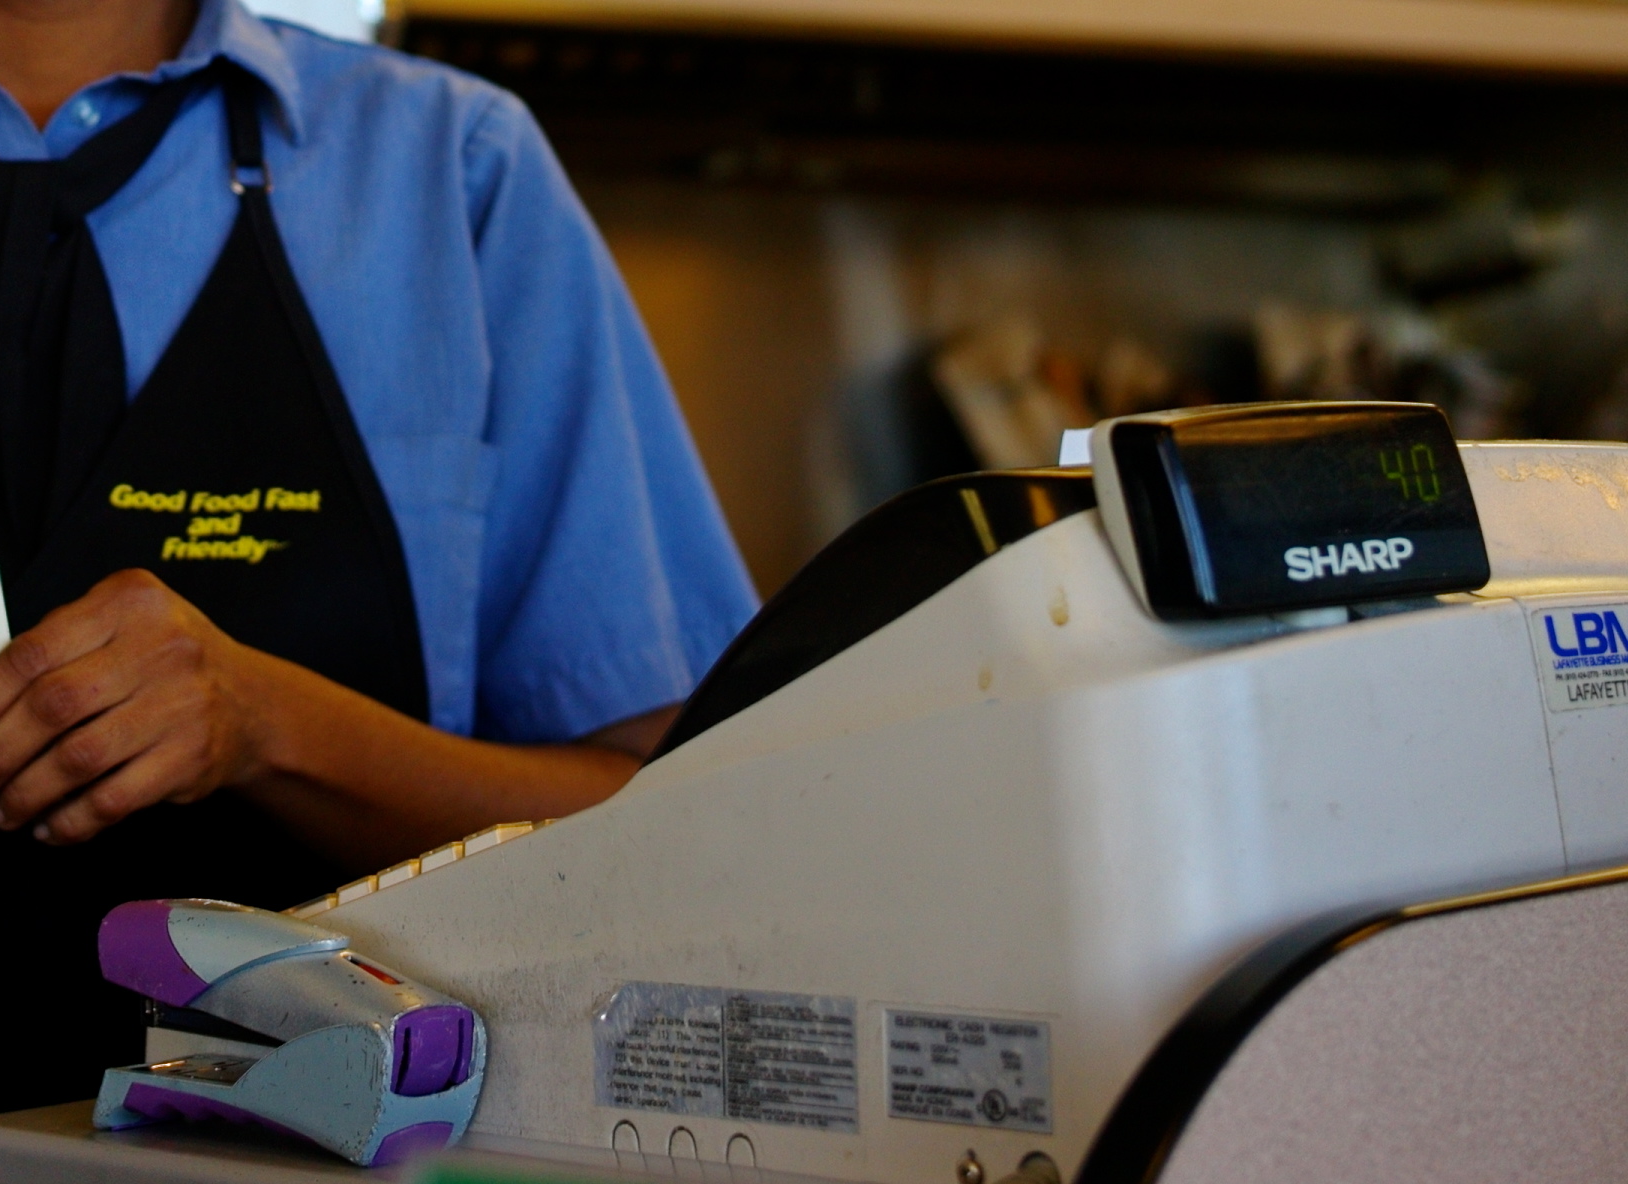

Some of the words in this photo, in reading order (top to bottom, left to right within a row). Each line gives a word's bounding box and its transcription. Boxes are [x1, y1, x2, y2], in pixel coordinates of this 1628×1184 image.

[1379, 443, 1440, 503] 40
[109, 484, 187, 513] Good
[189, 488, 261, 513] Food
[264, 487, 321, 513] Fast
[186, 512, 242, 536] and
[161, 536, 269, 564] Friendly
[1283, 537, 1414, 581] SHARP
[1567, 679, 1628, 702] LAFAYETT
[894, 1015, 953, 1030] ELECTRONIC
[957, 1020, 985, 1034] CASH
